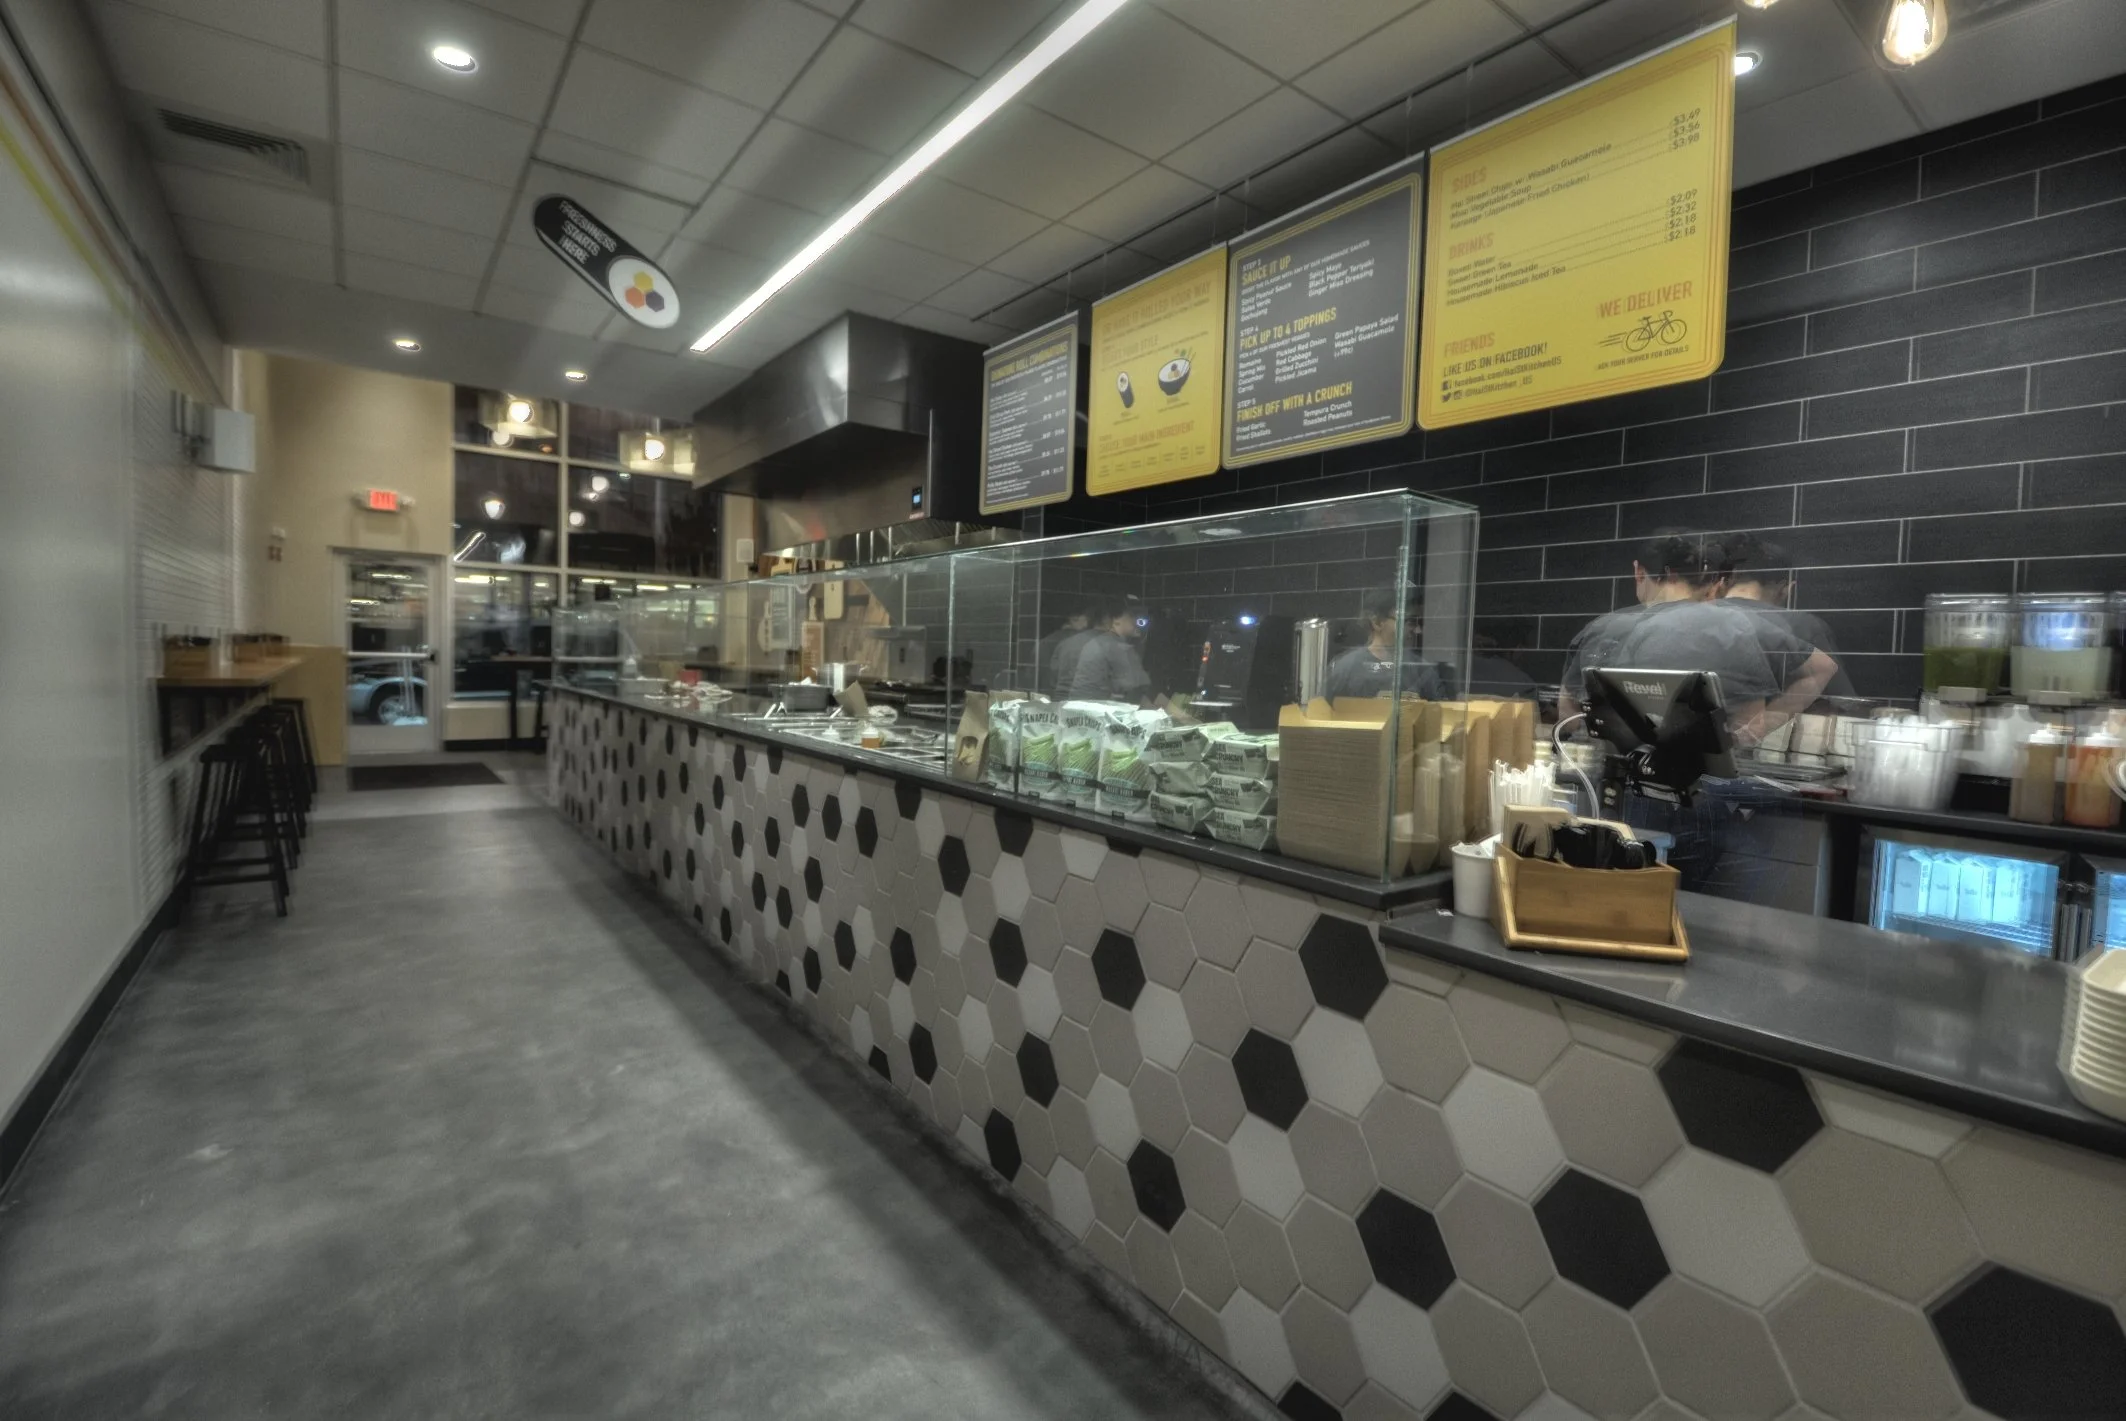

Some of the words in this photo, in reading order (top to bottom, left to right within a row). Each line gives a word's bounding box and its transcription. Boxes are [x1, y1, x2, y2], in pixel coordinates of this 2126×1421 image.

[1527, 163, 1558, 180] Wasabi
[1560, 143, 1611, 168] Guacamole
[1672, 107, 1700, 126] $3.49
[1470, 193, 1508, 211] Vegetable
[1510, 184, 1531, 198] Soup
[1672, 120, 1700, 138] $3.56
[1551, 172, 1589, 192] Chicken)
[1671, 132, 1699, 150] $3.98
[1452, 166, 1486, 192] SIDES
[562, 220, 601, 257] STARTS
[1472, 266, 1495, 278] Green
[1668, 200, 1696, 217] $2.32
[1473, 256, 1495, 267] Water
[1670, 188, 1697, 205] $2.09
[558, 235, 590, 265] HERE
[1449, 232, 1493, 259] DRINKS
[1495, 263, 1538, 281] Lemonade
[1668, 212, 1696, 229] $2.18
[1550, 265, 1566, 275] Tea
[1668, 224, 1696, 241] $2.18
[1242, 264, 1266, 285] SAUCE
[1279, 254, 1291, 270] UP
[1309, 269, 1324, 280] Spicy
[1325, 262, 1341, 272] Mayo
[1326, 269, 1348, 281] Pepper
[1345, 268, 1373, 283] Dressing
[1274, 282, 1292, 292] Sauce
[1596, 298, 1621, 318] WE
[1627, 280, 1692, 311] DELIVER
[1239, 334, 1257, 350] PICK
[1259, 329, 1271, 343] UP
[1293, 307, 1336, 332] TOPPINGS
[1334, 329, 1353, 339] Green
[1354, 321, 1377, 333] Papaya
[1379, 313, 1398, 326] Salad
[1334, 336, 1356, 348] Wasabi
[1357, 325, 1394, 341] Guacamole
[1309, 337, 1326, 347] Onion
[1444, 331, 1494, 357] FRIENDS
[1663, 344, 1689, 356] DETAILS
[1443, 362, 1462, 377] LIKE
[1464, 359, 1476, 372] US
[1479, 355, 1492, 368] ON
[1494, 341, 1547, 364] FACEBOOK!
[1236, 404, 1262, 421] FINISH
[1264, 399, 1280, 415] OFF
[1282, 394, 1304, 410] WITH
[1314, 381, 1352, 402] CRUNCH
[1303, 406, 1328, 417] Tempura
[1330, 400, 1352, 411] Crunch
[1327, 409, 1352, 420] Peanuts
